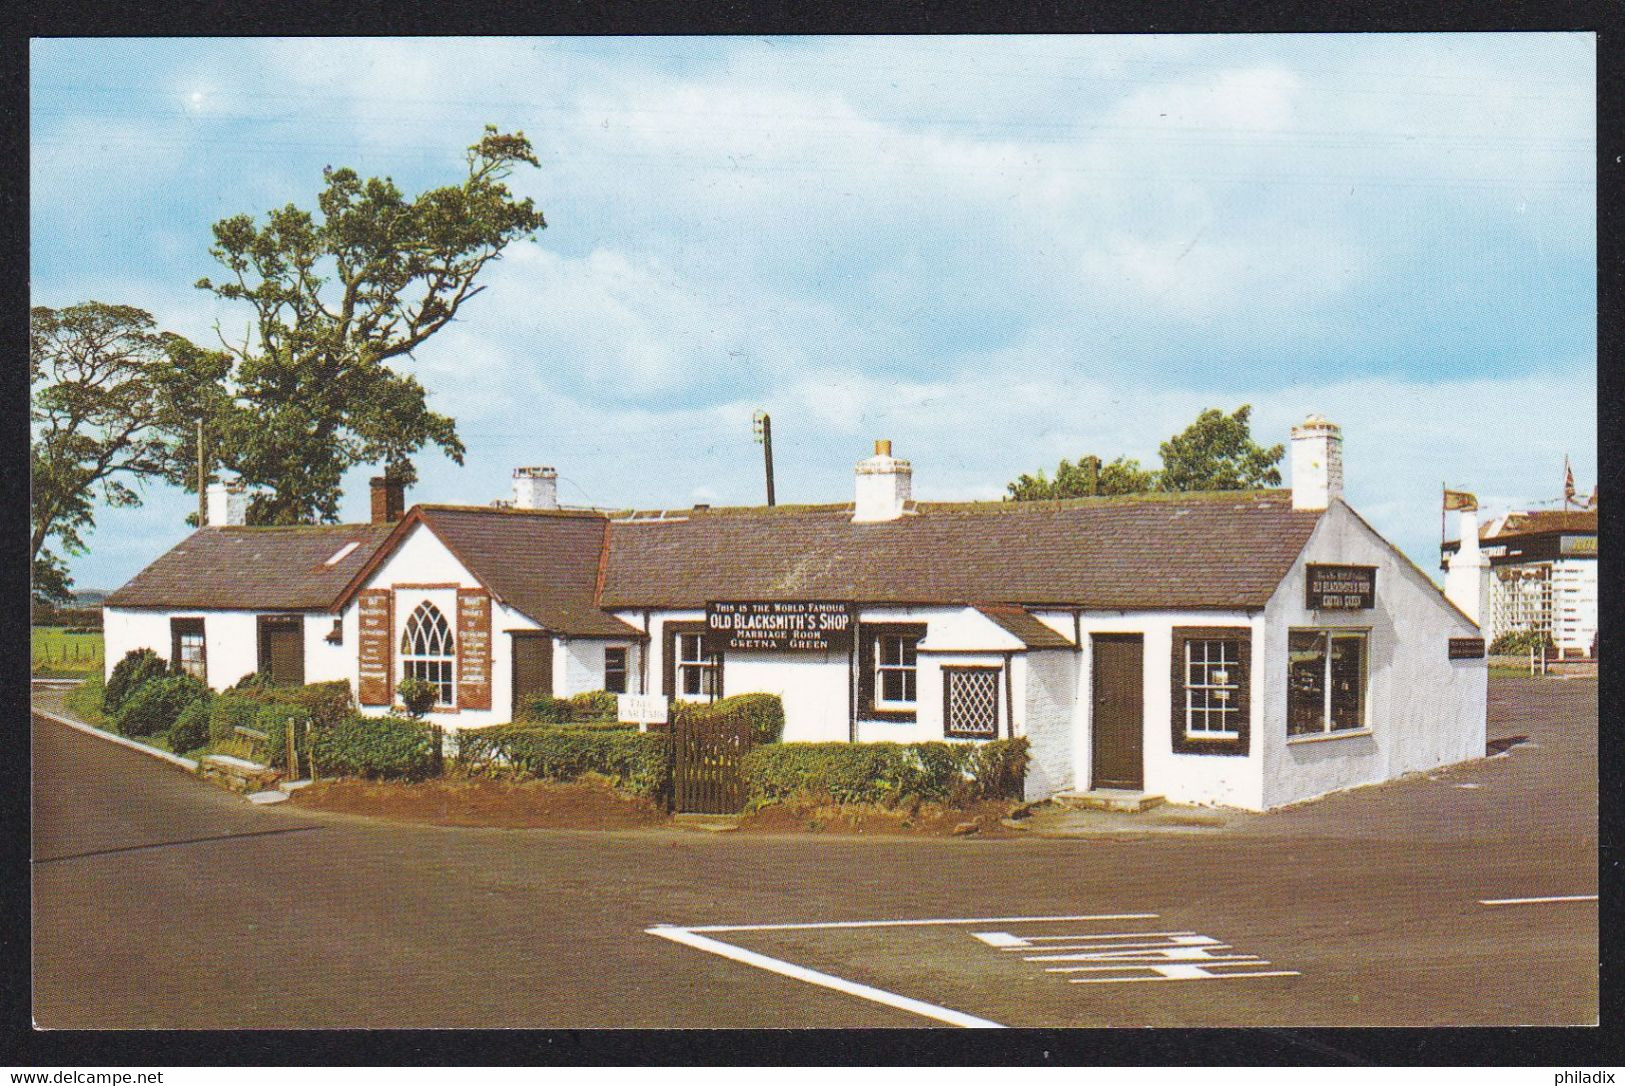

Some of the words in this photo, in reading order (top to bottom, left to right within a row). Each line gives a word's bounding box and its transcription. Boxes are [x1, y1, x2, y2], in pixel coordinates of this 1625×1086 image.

[753, 604, 769, 612] THE
[774, 603, 804, 612] WORLD
[808, 603, 845, 612] FAMOUS
[710, 613, 731, 629] OLD
[734, 613, 816, 630] BLACKSMITH'S
[819, 613, 849, 630] SHOP
[736, 630, 787, 639] MARRIAGE
[793, 630, 821, 639] ROOM
[730, 639, 778, 648] GRETNA
[789, 639, 828, 648] GREEN
